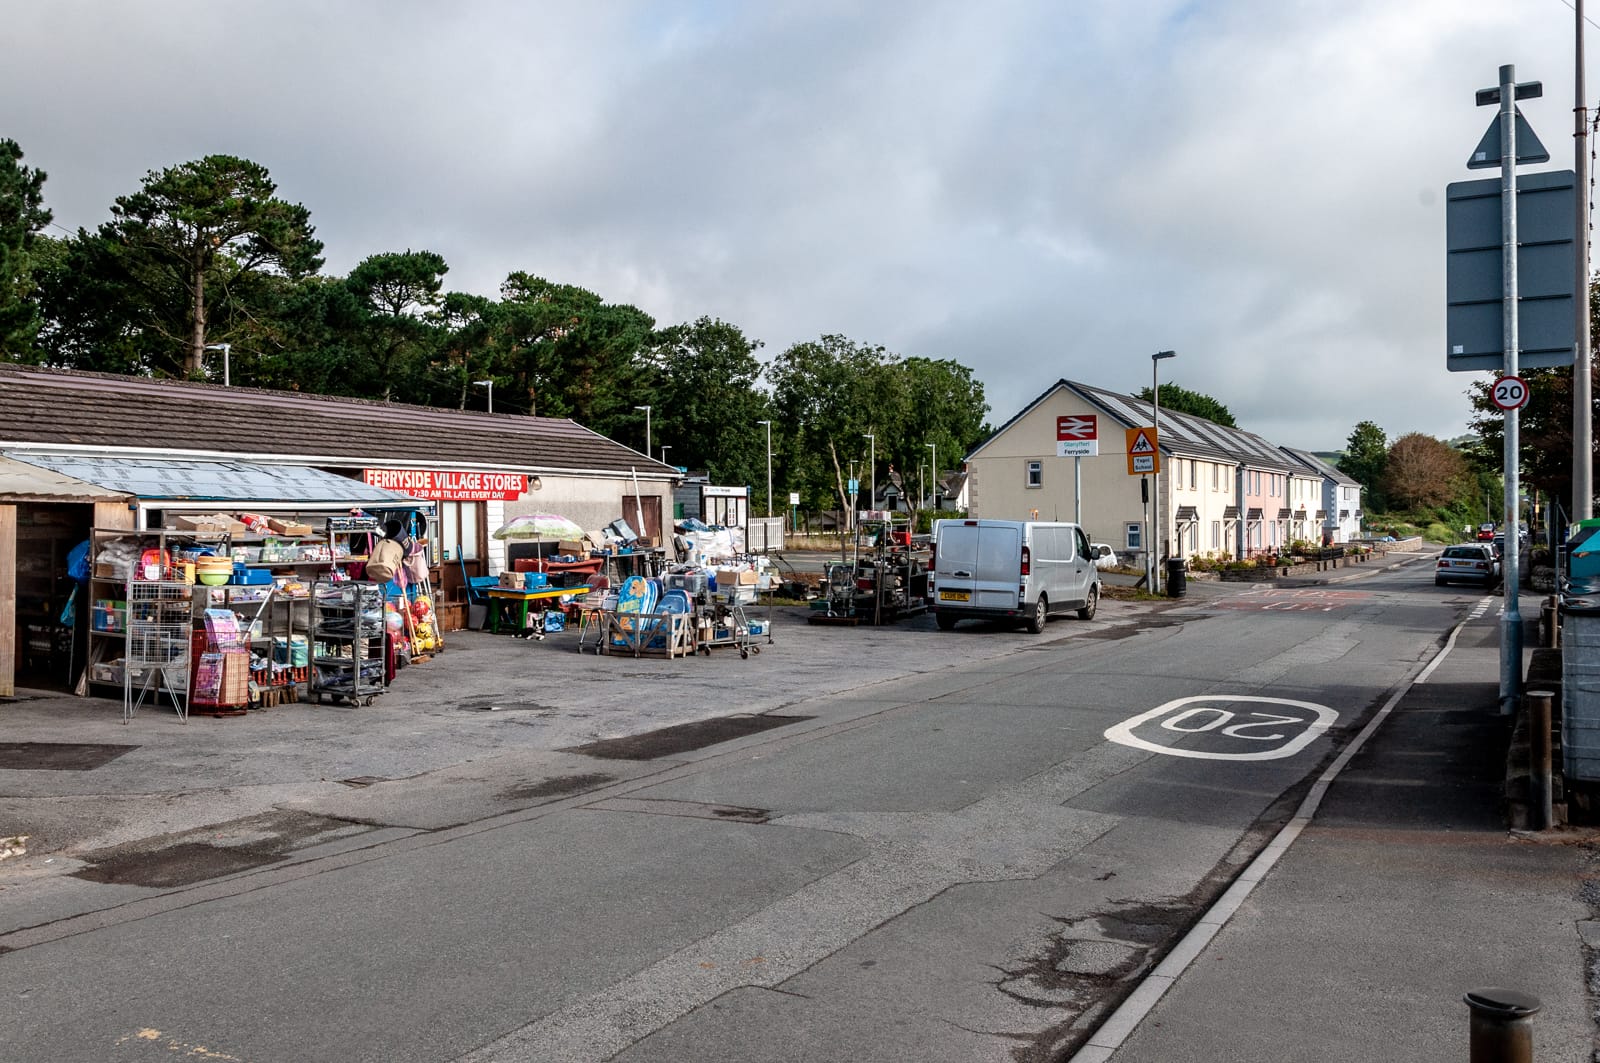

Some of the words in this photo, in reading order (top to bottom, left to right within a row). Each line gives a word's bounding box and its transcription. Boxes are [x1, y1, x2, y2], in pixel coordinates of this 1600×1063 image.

[1496, 385, 1523, 400] 20
[366, 469, 432, 489] FERRYSIDE
[433, 472, 481, 490] VILLAGE
[483, 474, 522, 491] STORES
[413, 489, 429, 498] 7:30
[430, 489, 442, 498] AM
[453, 490, 470, 499] LATE
[471, 490, 491, 499] EVERY
[491, 491, 506, 499] DAY
[1160, 707, 1305, 741] 20
